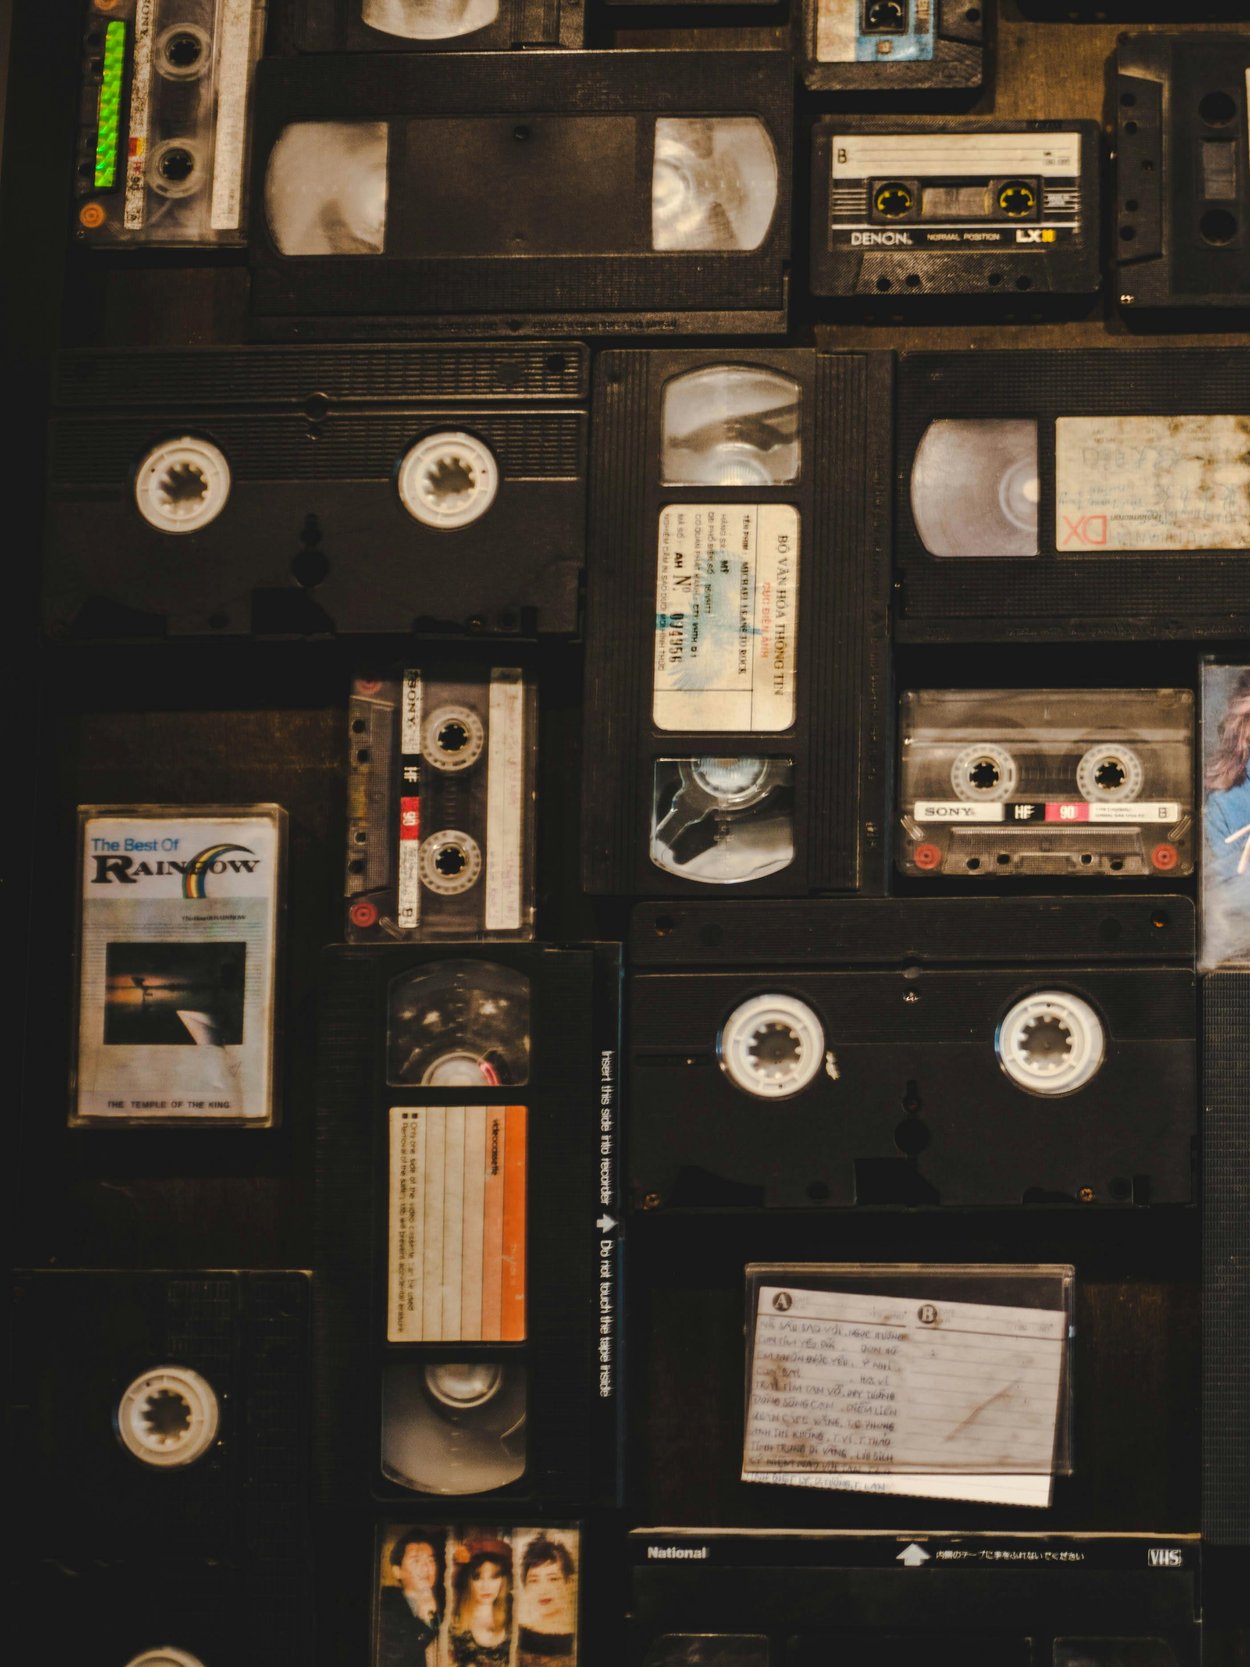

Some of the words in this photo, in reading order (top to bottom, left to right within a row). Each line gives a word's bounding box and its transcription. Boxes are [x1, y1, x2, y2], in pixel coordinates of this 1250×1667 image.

[838, 149, 847, 164] B
[851, 232, 908, 245] DENON
[927, 233, 960, 241] NORMAL
[964, 233, 1000, 241] POSITION
[1062, 515, 1108, 544] DX
[674, 553, 683, 568] AH
[740, 562, 748, 600] MICHAEL
[739, 635, 747, 648] TO
[774, 624, 788, 669] THÔNG
[738, 650, 747, 674] ROCK
[774, 673, 784, 696] TIN
[407, 679, 417, 725] SONY
[404, 766, 417, 783] HF
[402, 811, 416, 826] 90
[924, 807, 972, 816] SONY
[1060, 805, 1076, 818] 90
[91, 838, 120, 851] The
[124, 838, 158, 851] Best
[161, 838, 180, 851] Of
[600, 1050, 615, 1081] Insert
[600, 1085, 615, 1105] this
[108, 1101, 125, 1109] THE
[131, 1101, 167, 1109] TEMPLE
[171, 1101, 184, 1109] OF
[188, 1101, 205, 1109] THE
[209, 1101, 230, 1109] KING
[600, 1108, 615, 1132] side
[409, 1122, 417, 1140] Only
[491, 1120, 499, 1176] videocassette
[600, 1135, 615, 1154] into
[401, 1156, 408, 1164] of
[409, 1159, 417, 1173] side
[600, 1158, 615, 1205] recorder
[409, 1187, 417, 1199] the
[398, 1231, 406, 1260] prevent
[600, 1240, 615, 1257] Do
[600, 1260, 615, 1278] not
[600, 1281, 615, 1314] touch
[774, 1292, 791, 1310] A
[918, 1305, 936, 1323] B
[600, 1316, 615, 1334] the
[598, 1337, 613, 1362] tape
[599, 1365, 613, 1398] inside
[647, 1547, 707, 1559] National
[1150, 1549, 1180, 1566] VHS
